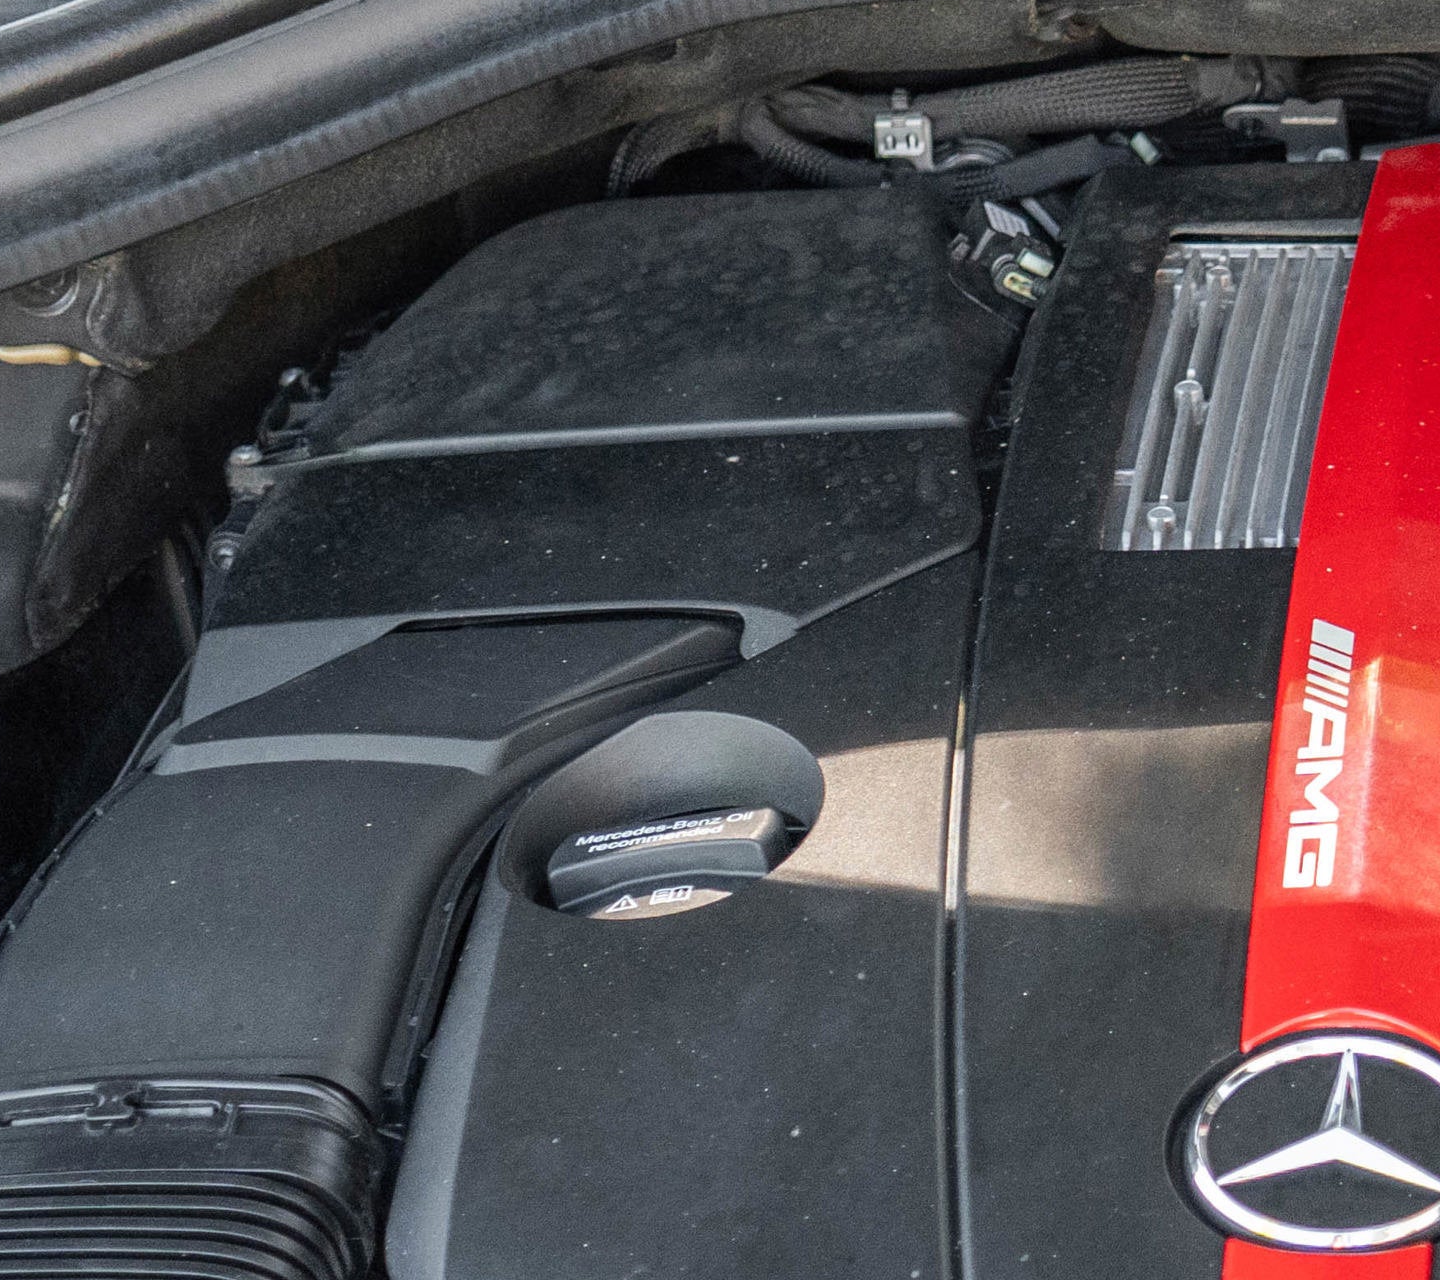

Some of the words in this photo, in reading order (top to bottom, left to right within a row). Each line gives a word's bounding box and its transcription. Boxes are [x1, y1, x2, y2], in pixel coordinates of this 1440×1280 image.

[1283, 698, 1351, 890] AMG
[574, 816, 724, 847] Mercedes-Benz
[726, 811, 754, 824] Oil
[587, 824, 725, 853] recommended
